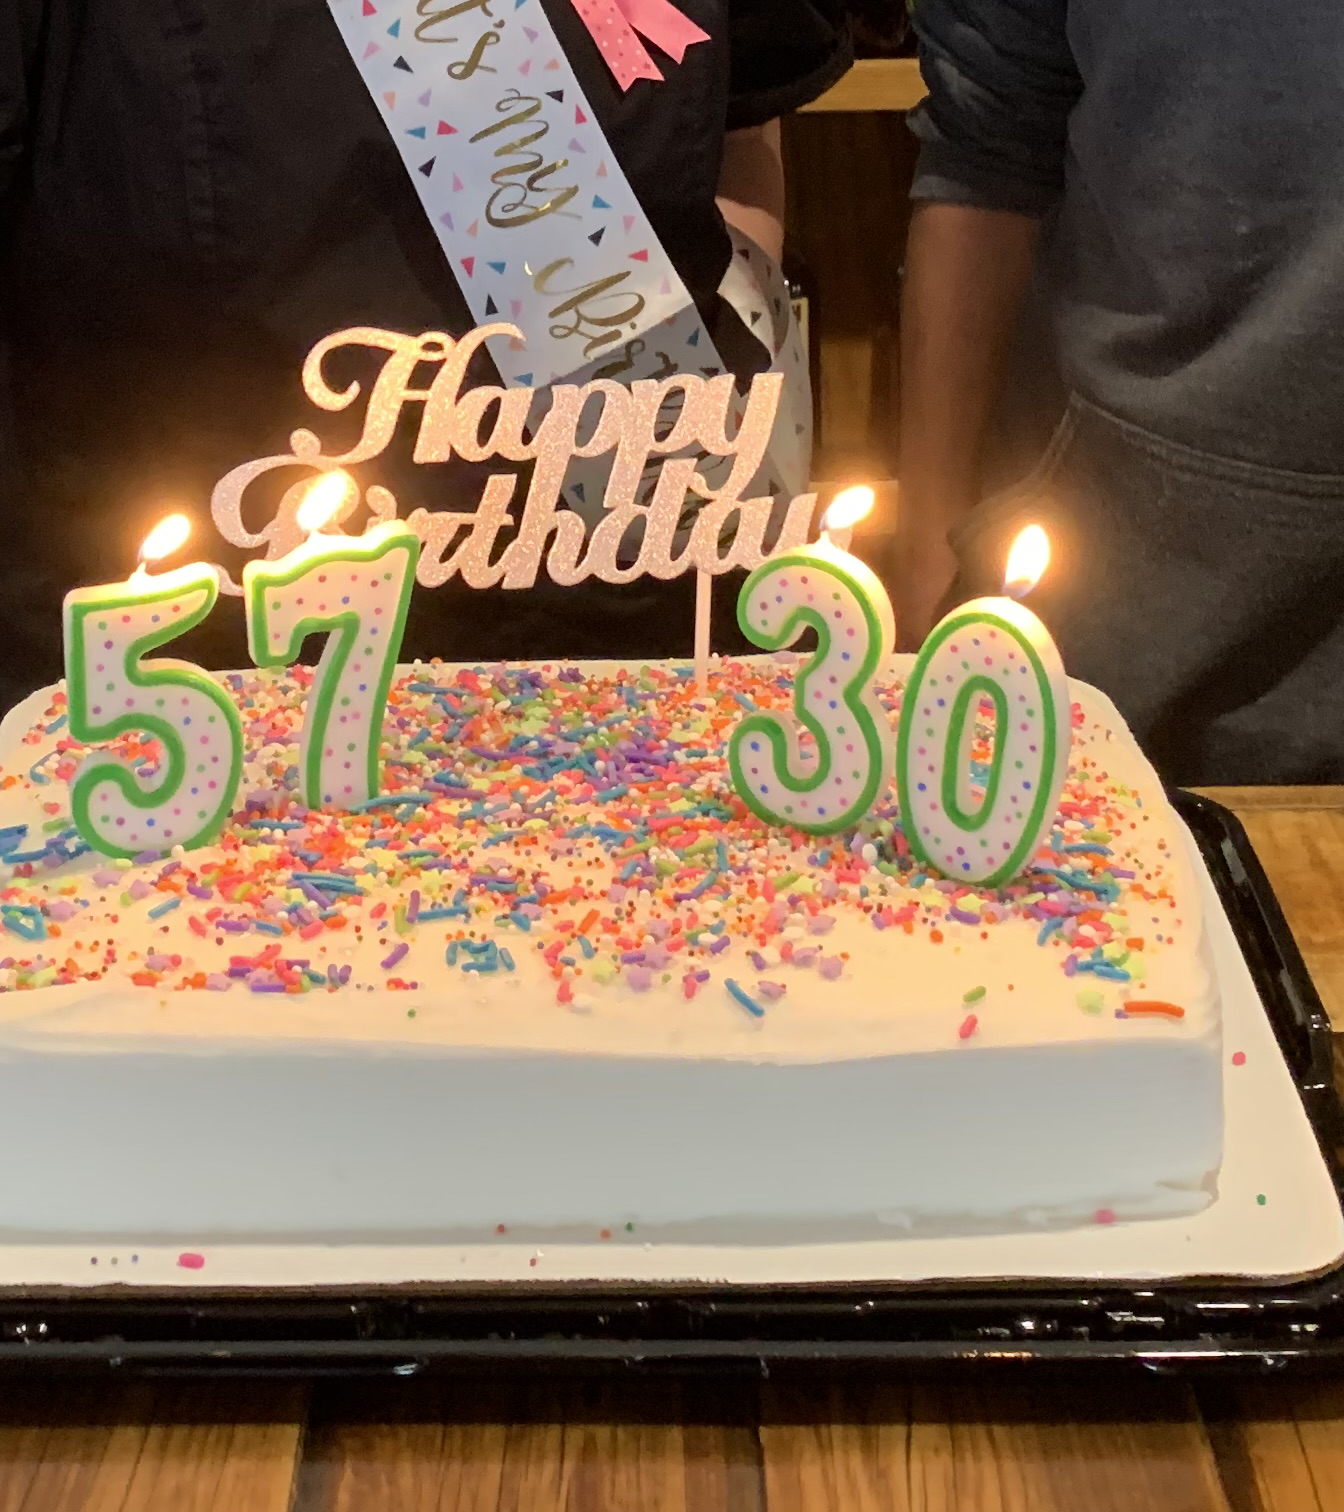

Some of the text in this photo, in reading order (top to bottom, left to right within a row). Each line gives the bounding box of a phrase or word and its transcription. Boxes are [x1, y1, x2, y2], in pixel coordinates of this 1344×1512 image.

[301, 319, 786, 510] Happy
[63, 519, 422, 862] 57
[727, 543, 1068, 890] 30
